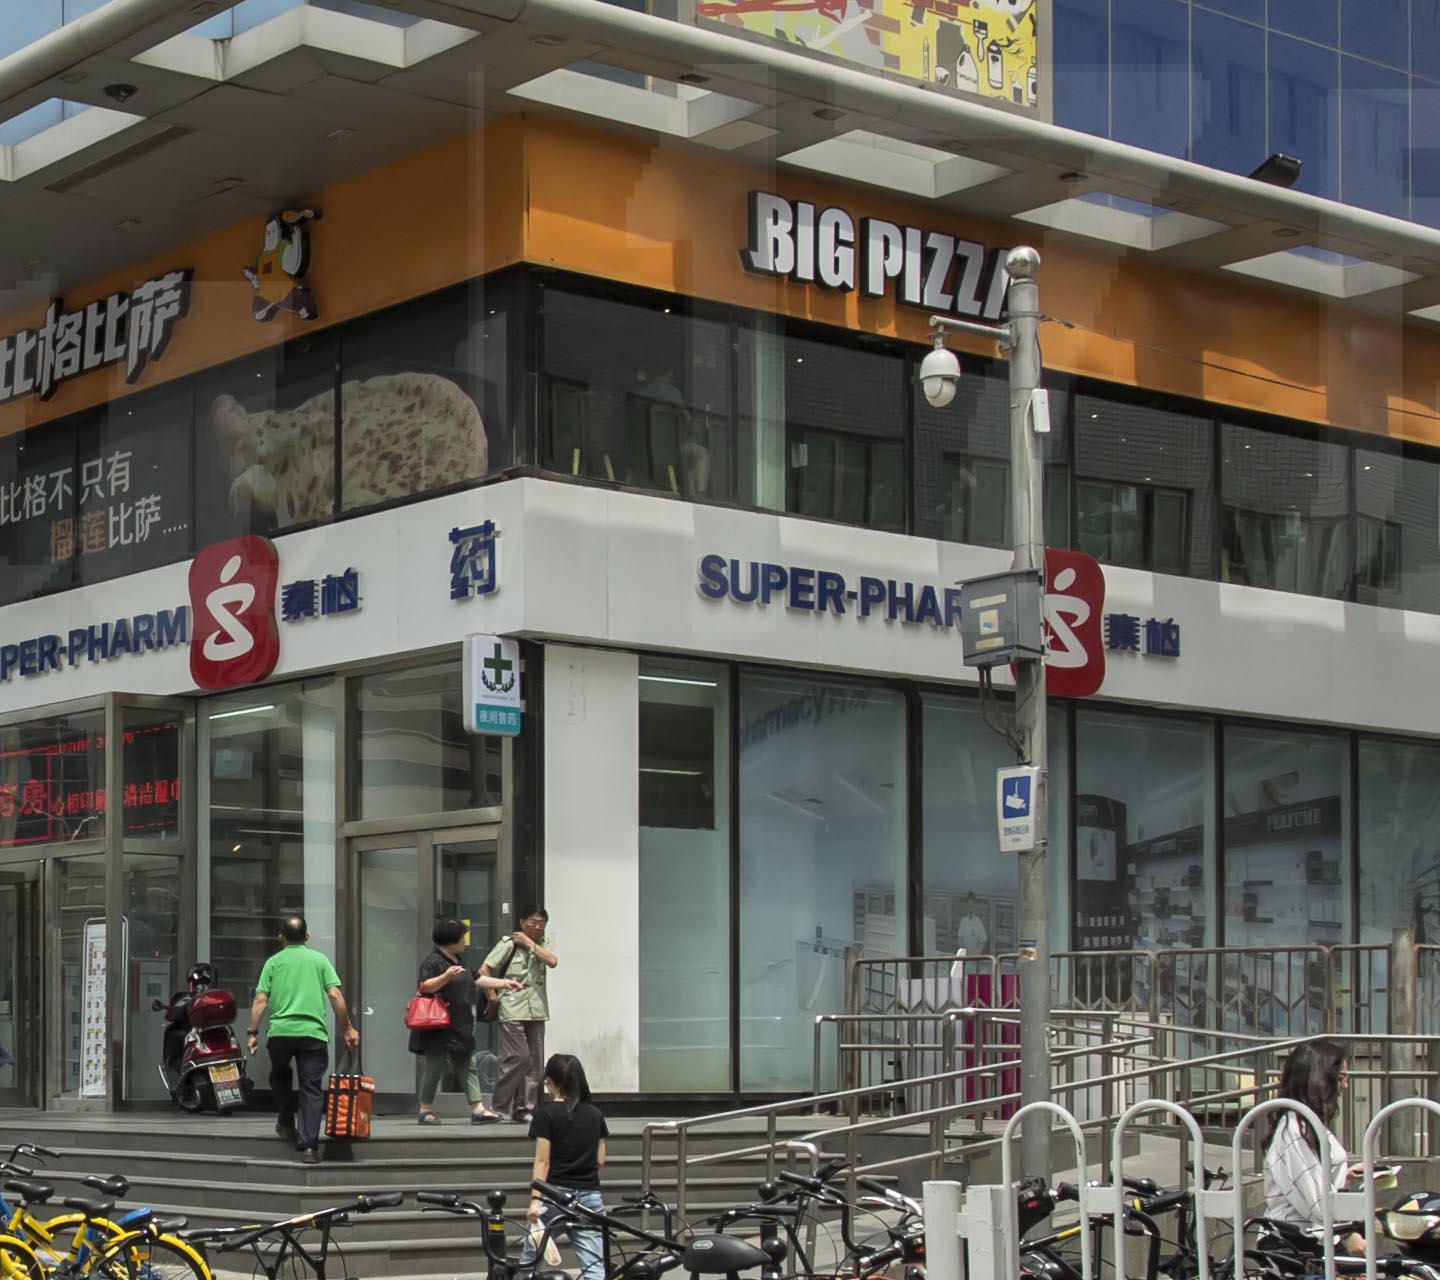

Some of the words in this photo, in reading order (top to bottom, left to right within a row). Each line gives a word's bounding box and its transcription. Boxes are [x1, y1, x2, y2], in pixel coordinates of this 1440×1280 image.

[752, 192, 856, 292] BIG
[0, 449, 133, 526] 比格不只有
[448, 518, 504, 602] 药
